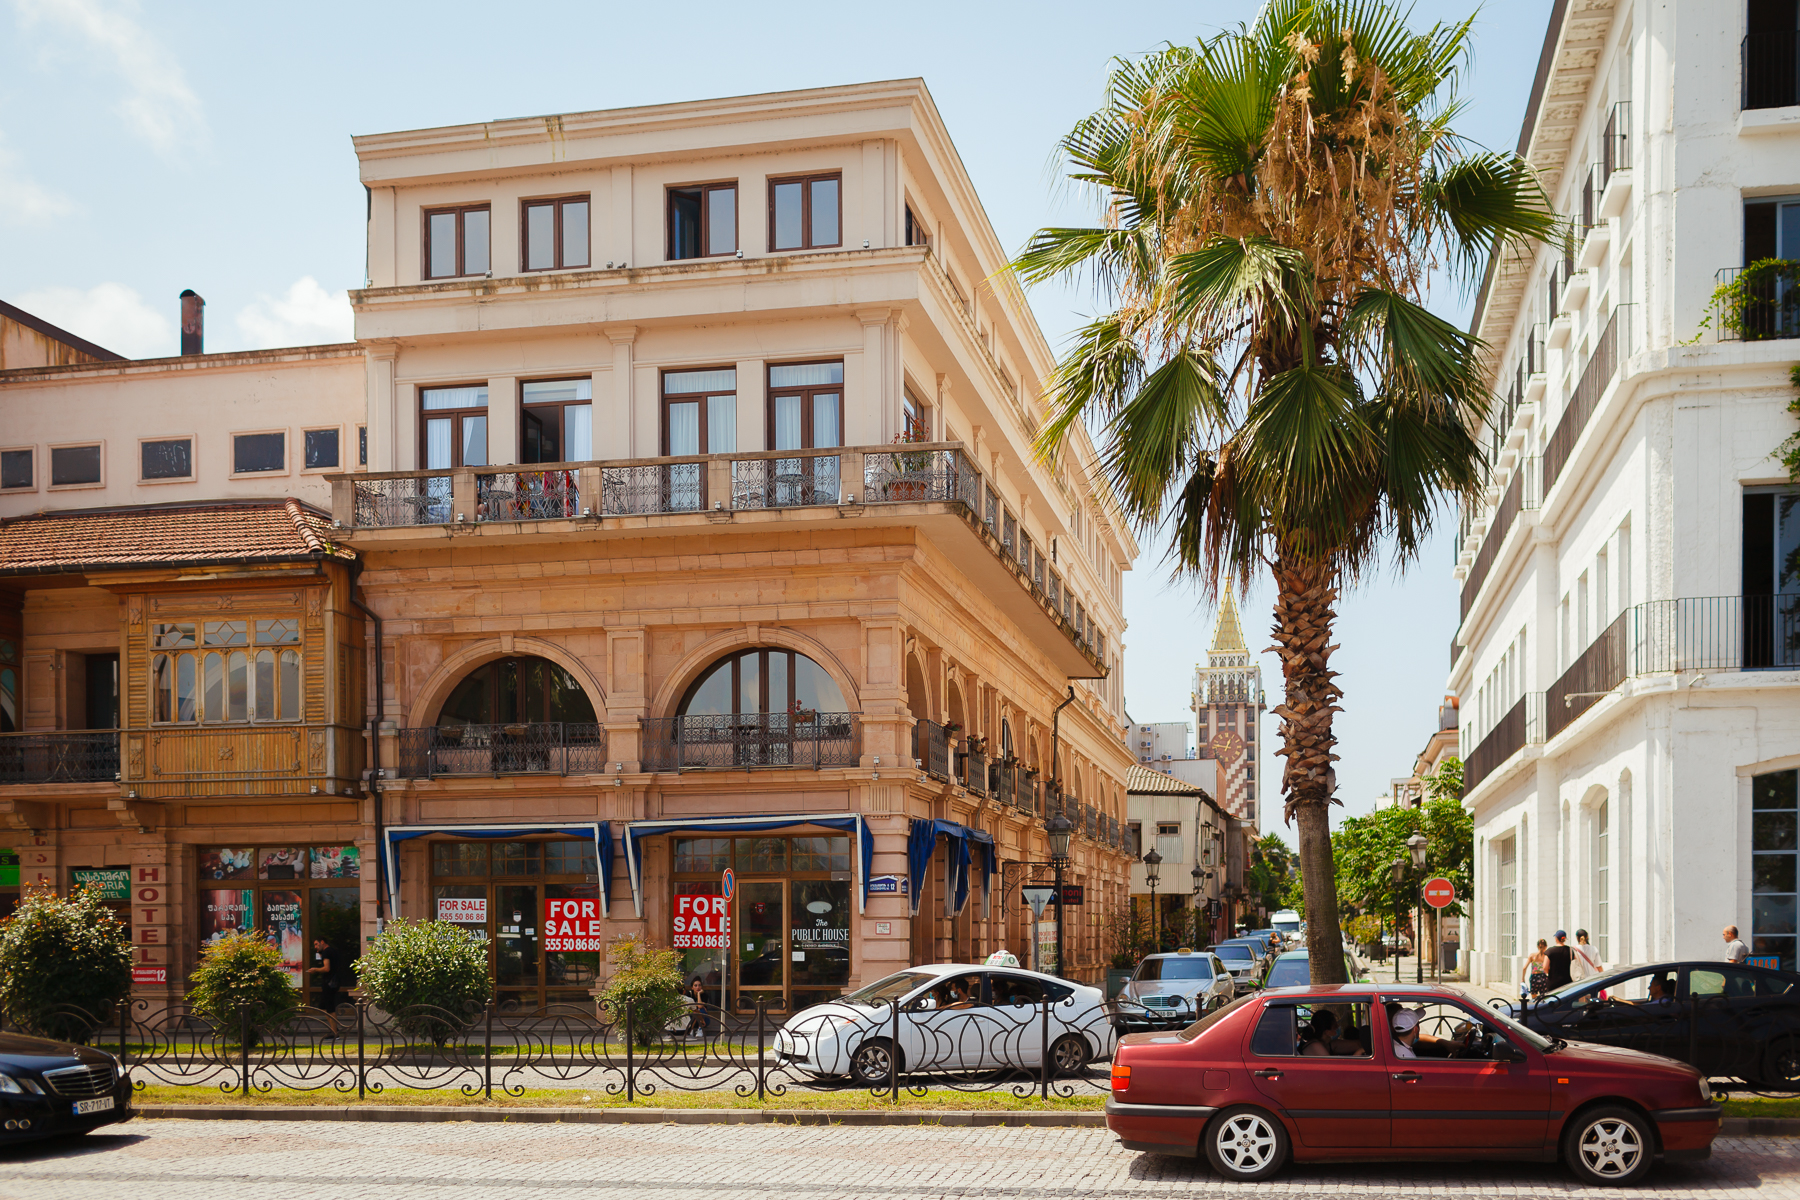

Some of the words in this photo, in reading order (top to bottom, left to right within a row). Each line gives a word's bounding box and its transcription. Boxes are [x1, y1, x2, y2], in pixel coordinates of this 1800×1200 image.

[75, 872, 130, 882] სასტუმრო
[96, 891, 122, 899] OTEL
[439, 900, 459, 911] FOR
[460, 900, 485, 911] SALE
[550, 901, 596, 919] FOR
[679, 897, 724, 915] FOR
[138, 868, 159, 963] HOTEL
[440, 913, 453, 921] 555
[454, 913, 464, 921] 50
[465, 913, 474, 921] 86
[475, 913, 485, 921] 86
[545, 920, 600, 936] SALE
[674, 917, 731, 933] SALE
[816, 919, 828, 927] The
[791, 929, 821, 941] PUBLIC
[822, 929, 849, 941] HOUSE
[545, 938, 562, 951] 555
[562, 938, 575, 951] 50
[575, 938, 588, 951] 86
[588, 938, 600, 951] 86
[674, 935, 690, 948] 555
[691, 935, 704, 948] 50
[705, 935, 717, 948] 86
[157, 969, 166, 981] 12
